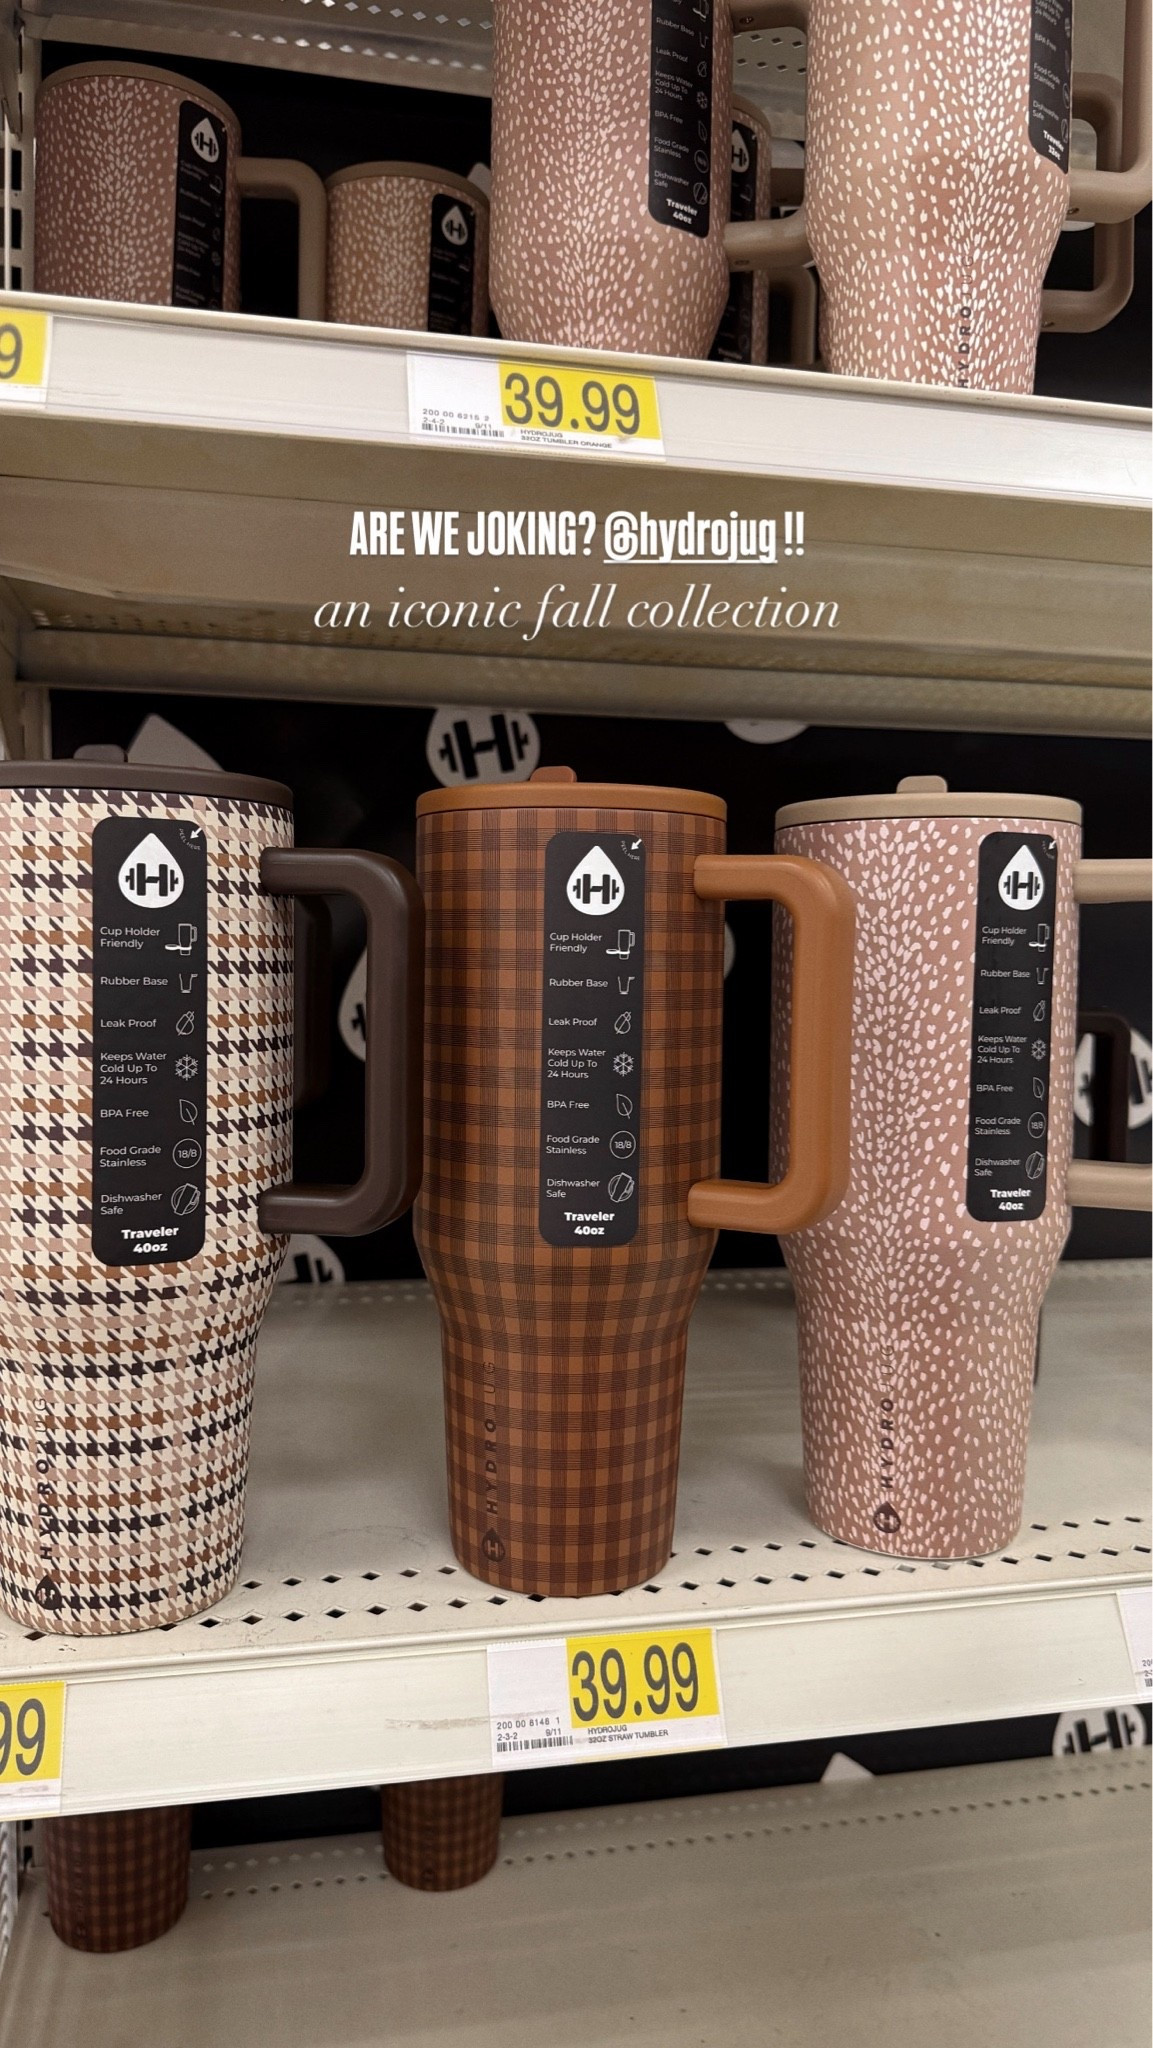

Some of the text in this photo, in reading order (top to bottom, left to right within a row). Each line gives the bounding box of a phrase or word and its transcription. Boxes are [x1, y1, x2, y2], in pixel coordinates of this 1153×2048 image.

[656, 17, 694, 36] Rubber Base
[656, 47, 688, 62] Leak Proof
[656, 71, 693, 88] Keeps Water
[655, 79, 688, 94] Cold Up To
[664, 90, 682, 100] Hours
[655, 110, 683, 124] BPA Free
[654, 137, 689, 153] Food Grade
[654, 145, 681, 158] Stainless
[654, 170, 689, 186] Dishwasher
[654, 179, 668, 188] Safe
[666, 198, 698, 216] Traveler
[673, 211, 692, 224] 40oz
[505, 373, 640, 435] 39.99
[422, 408, 440, 416] 200
[520, 429, 563, 438] HYDROJUG
[543, 437, 579, 445] TUMBLER
[100, 926, 160, 937] Cup Holder
[982, 926, 1027, 935] Cup Holder
[550, 932, 602, 942] Cup Holder
[982, 937, 1015, 946] Friendly
[100, 939, 144, 950] Friendly
[550, 944, 587, 954] Friendly
[980, 969, 1030, 978] Rubber Base
[100, 976, 168, 986] Rubber Base
[549, 978, 608, 988] Rubber Base
[100, 1019, 157, 1028] Leak Proof
[548, 1018, 597, 1026] Leak Proof
[978, 1035, 1004, 1044] Keeps
[548, 1048, 576, 1057] Keeps
[977, 1045, 997, 1053] Cold
[998, 1046, 1010, 1054] Up
[100, 1052, 167, 1062] Keeps Water
[100, 1064, 157, 1074] Cold Up To
[548, 1059, 597, 1069] Cold Up To
[547, 1070, 589, 1079] 24 Hours
[100, 1076, 148, 1084] 24 Hours
[547, 1101, 589, 1109] BPA Free
[100, 1109, 149, 1118] BPA Free
[998, 1117, 1021, 1125] Grade
[546, 1135, 632, 1149] Food Grade 18/8
[100, 1145, 197, 1159] Food Grade 18/8
[546, 1146, 587, 1155] Stainless
[100, 1158, 146, 1167] Stainless
[975, 1158, 1021, 1166] Dishwasher
[974, 1169, 992, 1177] Safe
[547, 1179, 600, 1187] Dishwasher
[101, 1193, 162, 1203] Dishwasher
[546, 1190, 566, 1198] Safe
[990, 1188, 1031, 1198] Traveler
[100, 1206, 124, 1215] Safe
[998, 1202, 1024, 1211] 40oz
[564, 1211, 615, 1221] Traveler
[121, 1226, 179, 1240] Traveler
[574, 1226, 605, 1235] 40oz
[133, 1243, 168, 1253] 40oz
[881, 1345, 895, 1489] HYDROJUG
[572, 1642, 699, 1722] 39.99
[497, 1721, 512, 1730] 200
[515, 1720, 526, 1728] 00
[588, 1724, 628, 1734] HYDROJUG
[497, 1728, 561, 1741] 2-3-2 9/11
[588, 1729, 669, 1744] 32OZ STRAW TUMBLER
